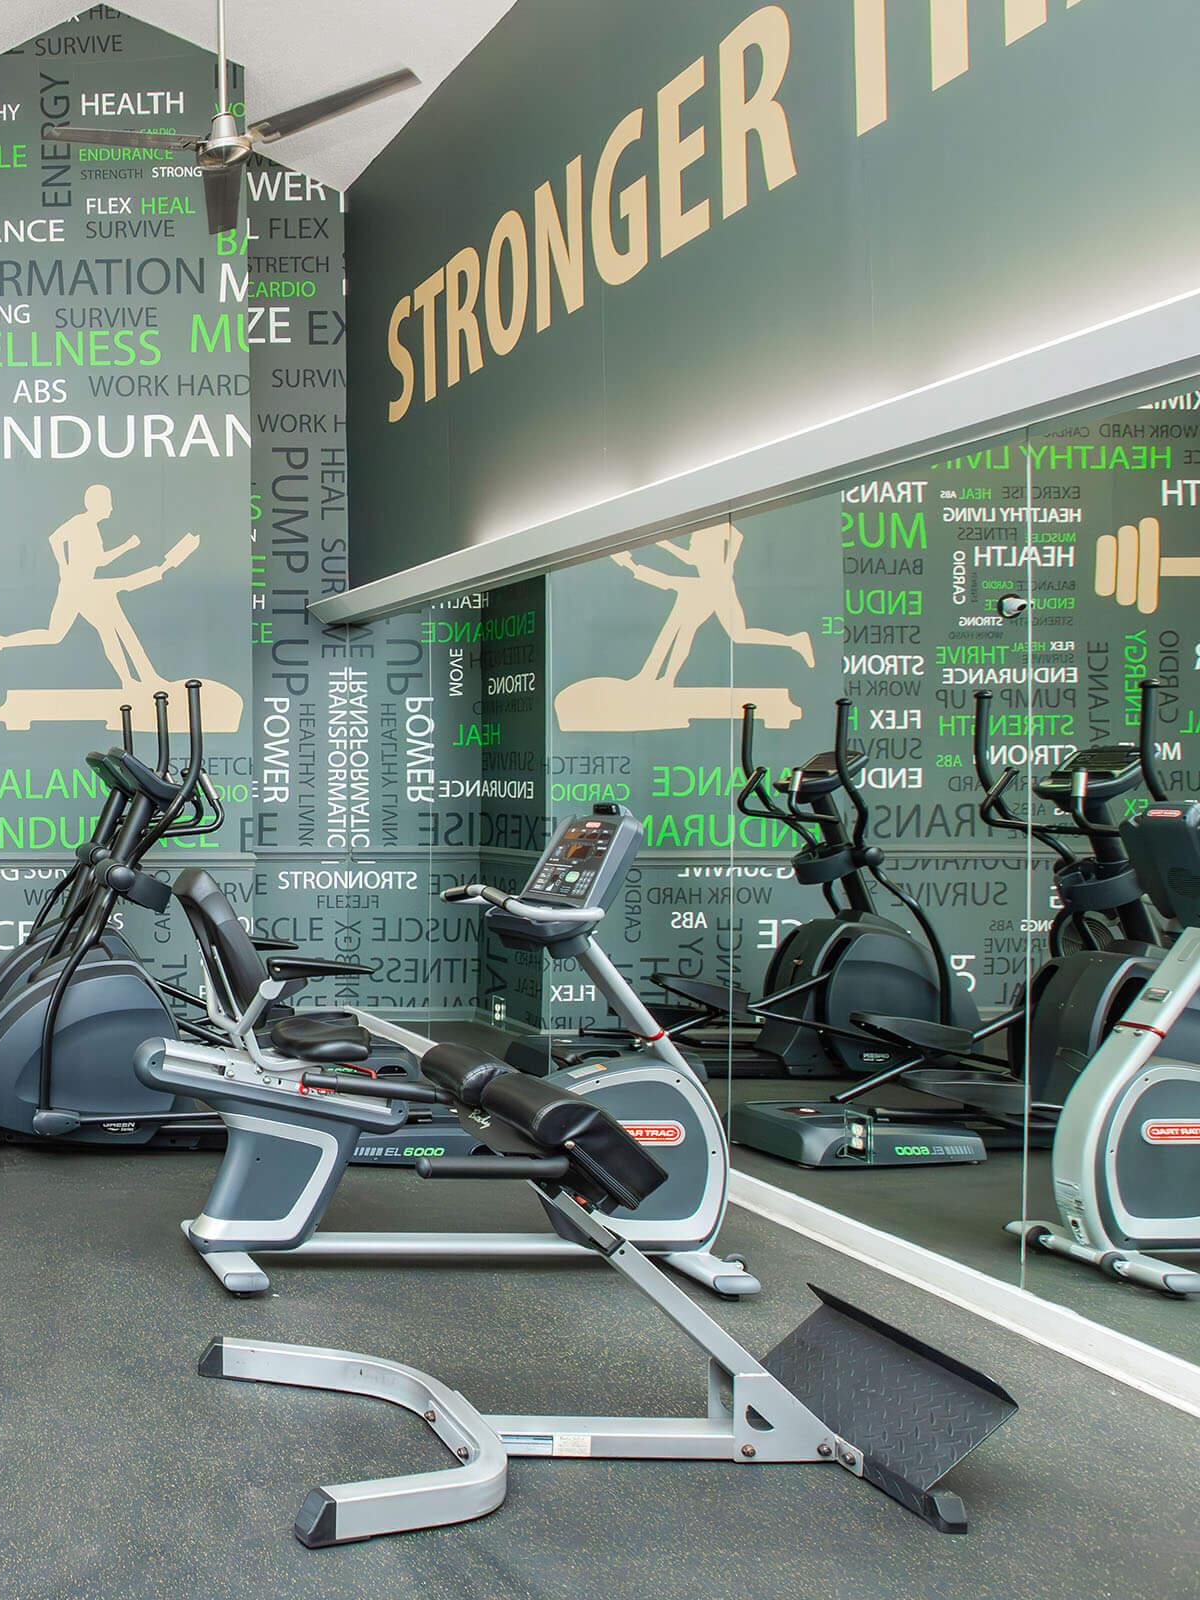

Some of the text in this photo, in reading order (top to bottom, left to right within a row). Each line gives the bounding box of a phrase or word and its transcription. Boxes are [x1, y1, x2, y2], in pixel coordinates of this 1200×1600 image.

[35, 34, 123, 56] SURVIVE
[80, 92, 184, 116] HEALTH
[80, 169, 143, 180] STRENGTH
[152, 167, 202, 178] STRONG
[86, 198, 131, 214] FLEX
[141, 197, 195, 214] HEAL
[388, 3, 798, 423] STRONGER
[86, 220, 175, 238] SURVIVE
[269, 218, 329, 239] FLEX
[55, 307, 158, 328] SURVIVE
[13, 379, 66, 403] ABS
[88, 375, 169, 397] WORK
[258, 414, 327, 433] WORK
[321, 448, 344, 521] HEAL
[271, 447, 309, 696] PUMP IT UP
[263, 697, 290, 803] POWER
[299, 704, 315, 788] HEALTHY
[403, 1148, 445, 1156] 6000
